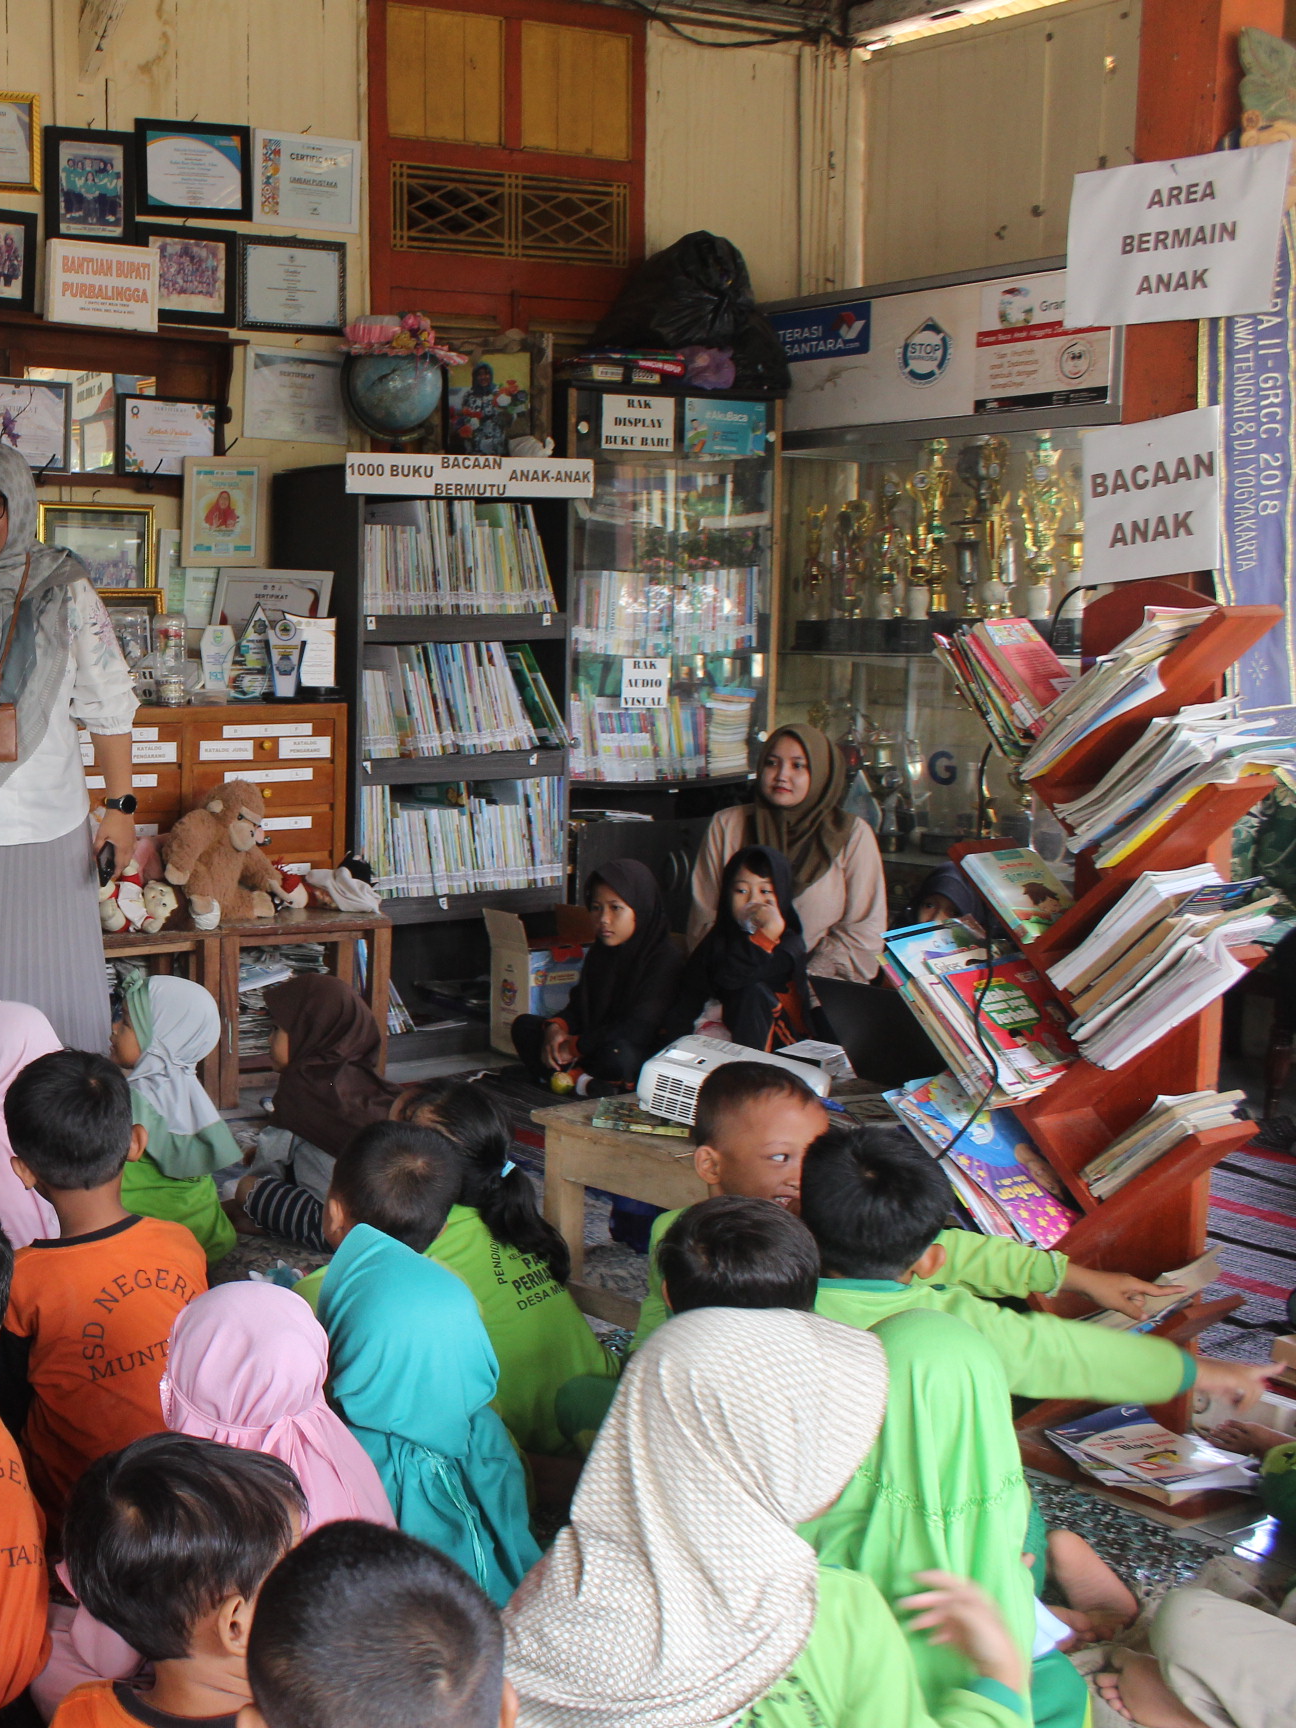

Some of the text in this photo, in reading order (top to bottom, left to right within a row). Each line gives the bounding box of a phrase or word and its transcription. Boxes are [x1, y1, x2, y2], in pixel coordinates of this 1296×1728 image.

[1146, 180, 1215, 209] AREA
[1121, 220, 1236, 255] BERMAIN
[61, 254, 151, 281] BANTUAN BUPATI
[61, 281, 149, 304] PURBALINGGA
[1135, 268, 1210, 295] ANAK
[777, 325, 823, 343] TERASI
[1234, 316, 1256, 350] AWA
[910, 342, 942, 355] STOP
[1232, 350, 1258, 419] TENGAH
[627, 398, 653, 410] RAK
[613, 416, 664, 429] DISPLAY
[1230, 420, 1256, 437] &
[605, 434, 673, 448] BUKU BARU
[347, 462, 434, 479] 1000 BUKU
[440, 456, 503, 470] BACAAN
[508, 469, 592, 483] ANAK-ANAK
[1090, 450, 1215, 499] BACAAN
[1257, 452, 1284, 516] 2018
[433, 483, 507, 496] BERMUTU
[1108, 510, 1195, 549] ANAK
[632, 660, 658, 670] RAK
[625, 679, 662, 689] AUDIO
[623, 696, 665, 707] VISUAL
[928, 750, 957, 786] G
[516, 1289, 552, 1311] DESA
[82, 1321, 105, 1361] SD
[89, 1340, 173, 1382] MUNT
